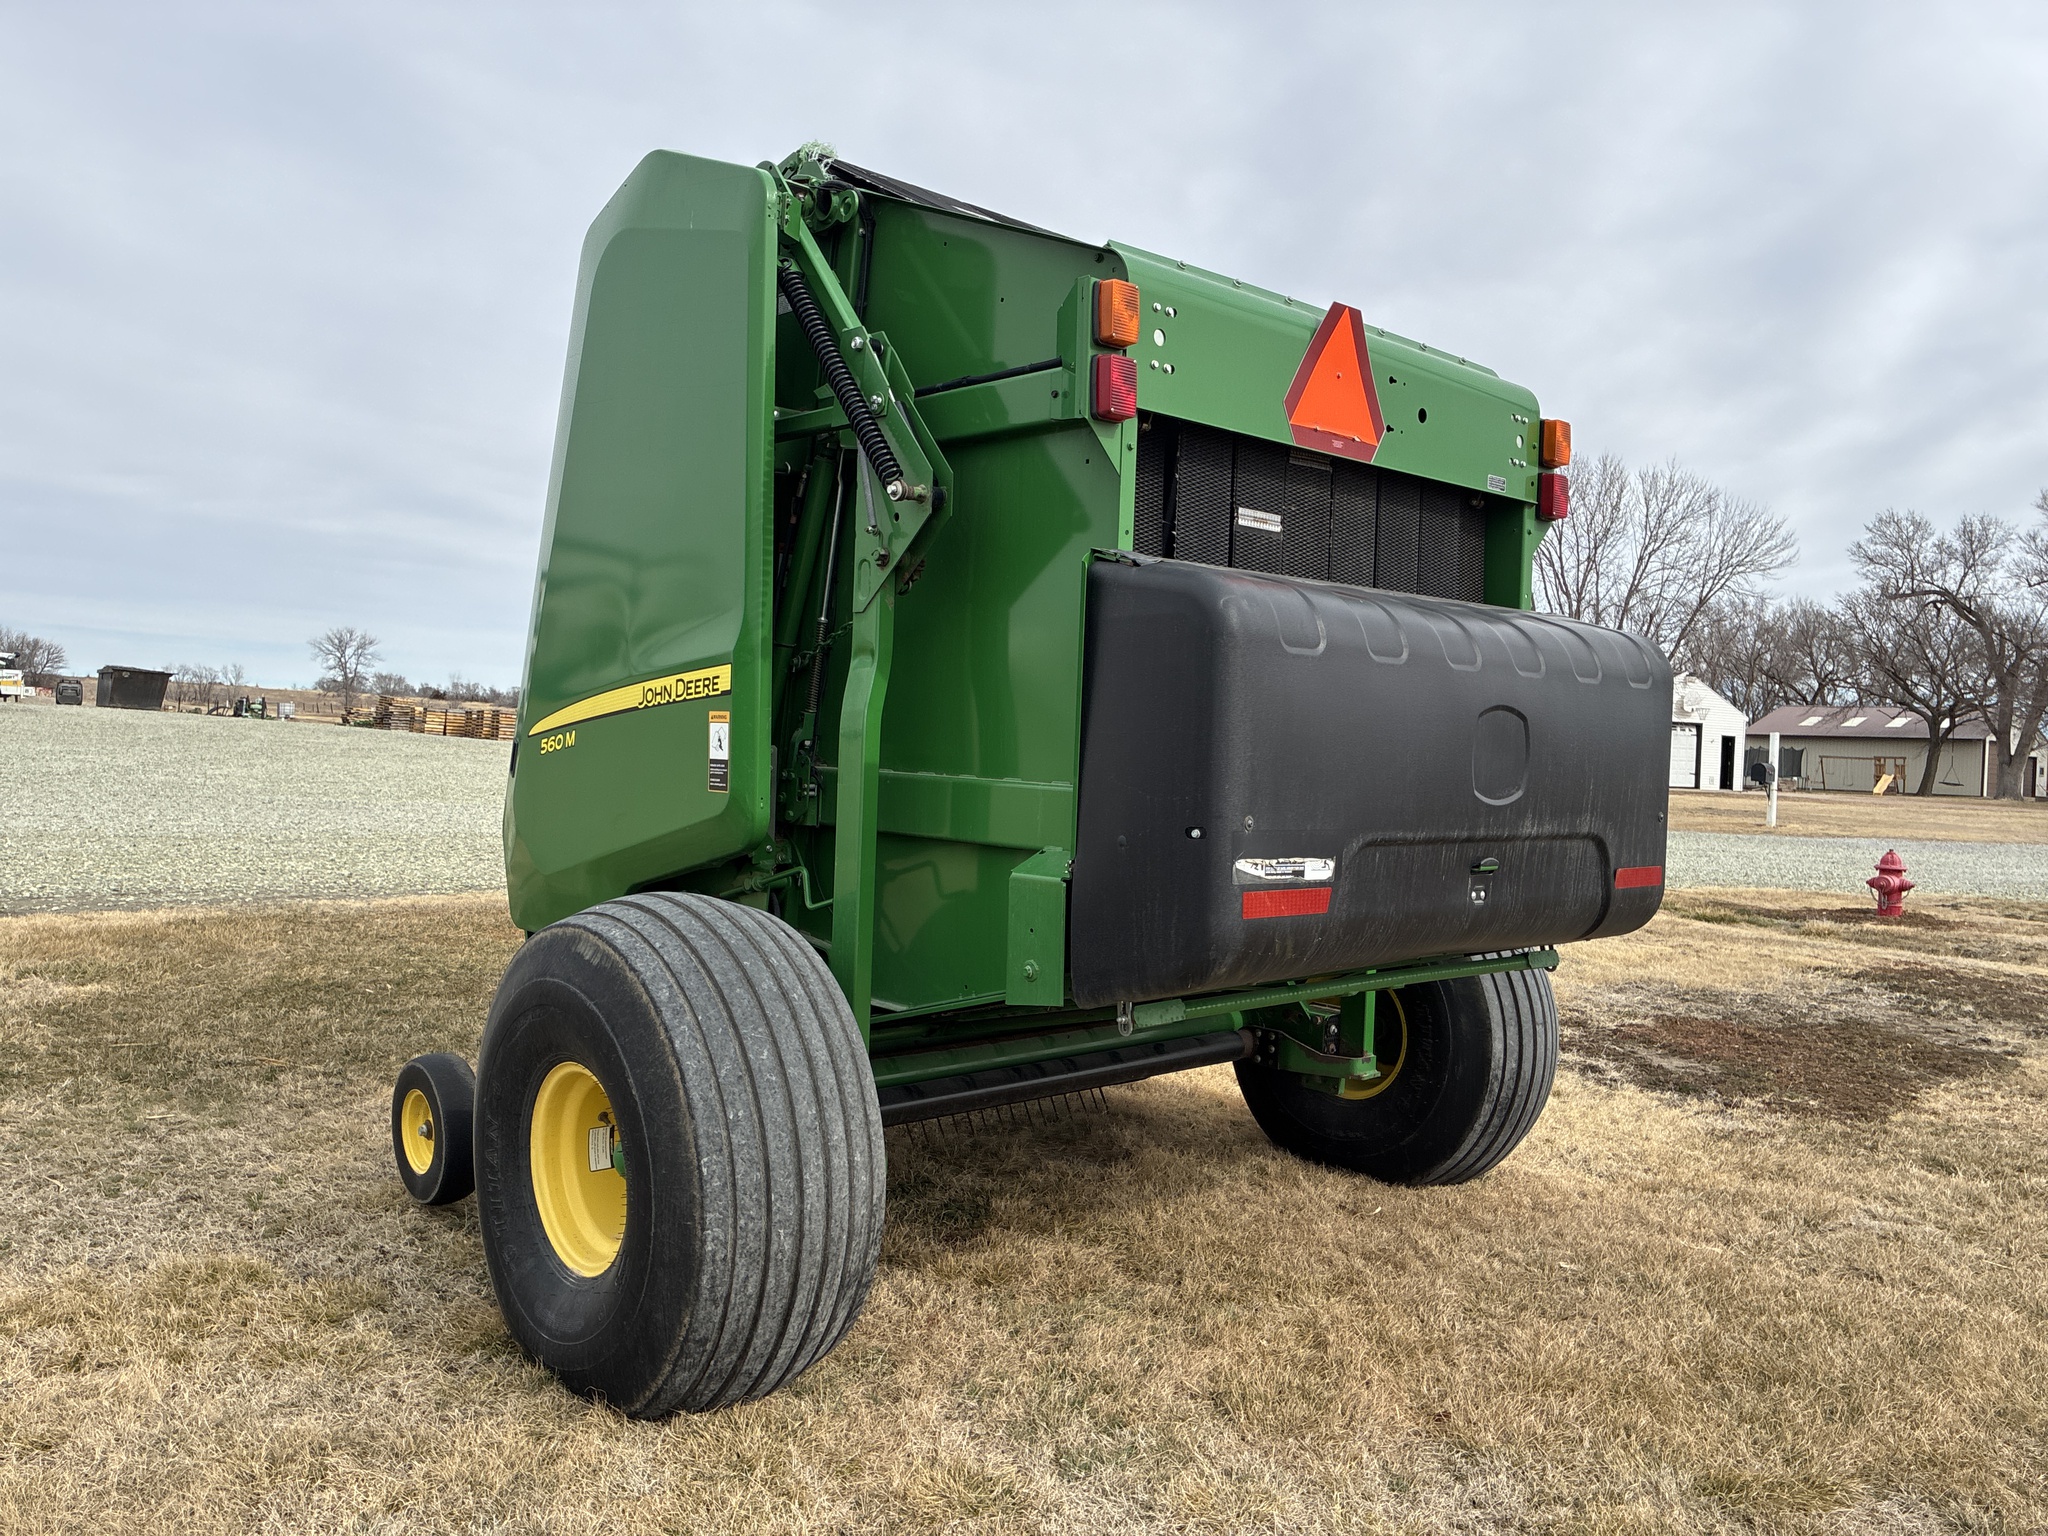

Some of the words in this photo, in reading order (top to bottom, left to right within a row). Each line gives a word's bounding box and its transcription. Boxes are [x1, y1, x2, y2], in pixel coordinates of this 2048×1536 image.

[638, 685, 672, 705] JOHN
[675, 675, 720, 698] DEERE
[540, 733, 564, 754] 560
[565, 730, 576, 748] M
